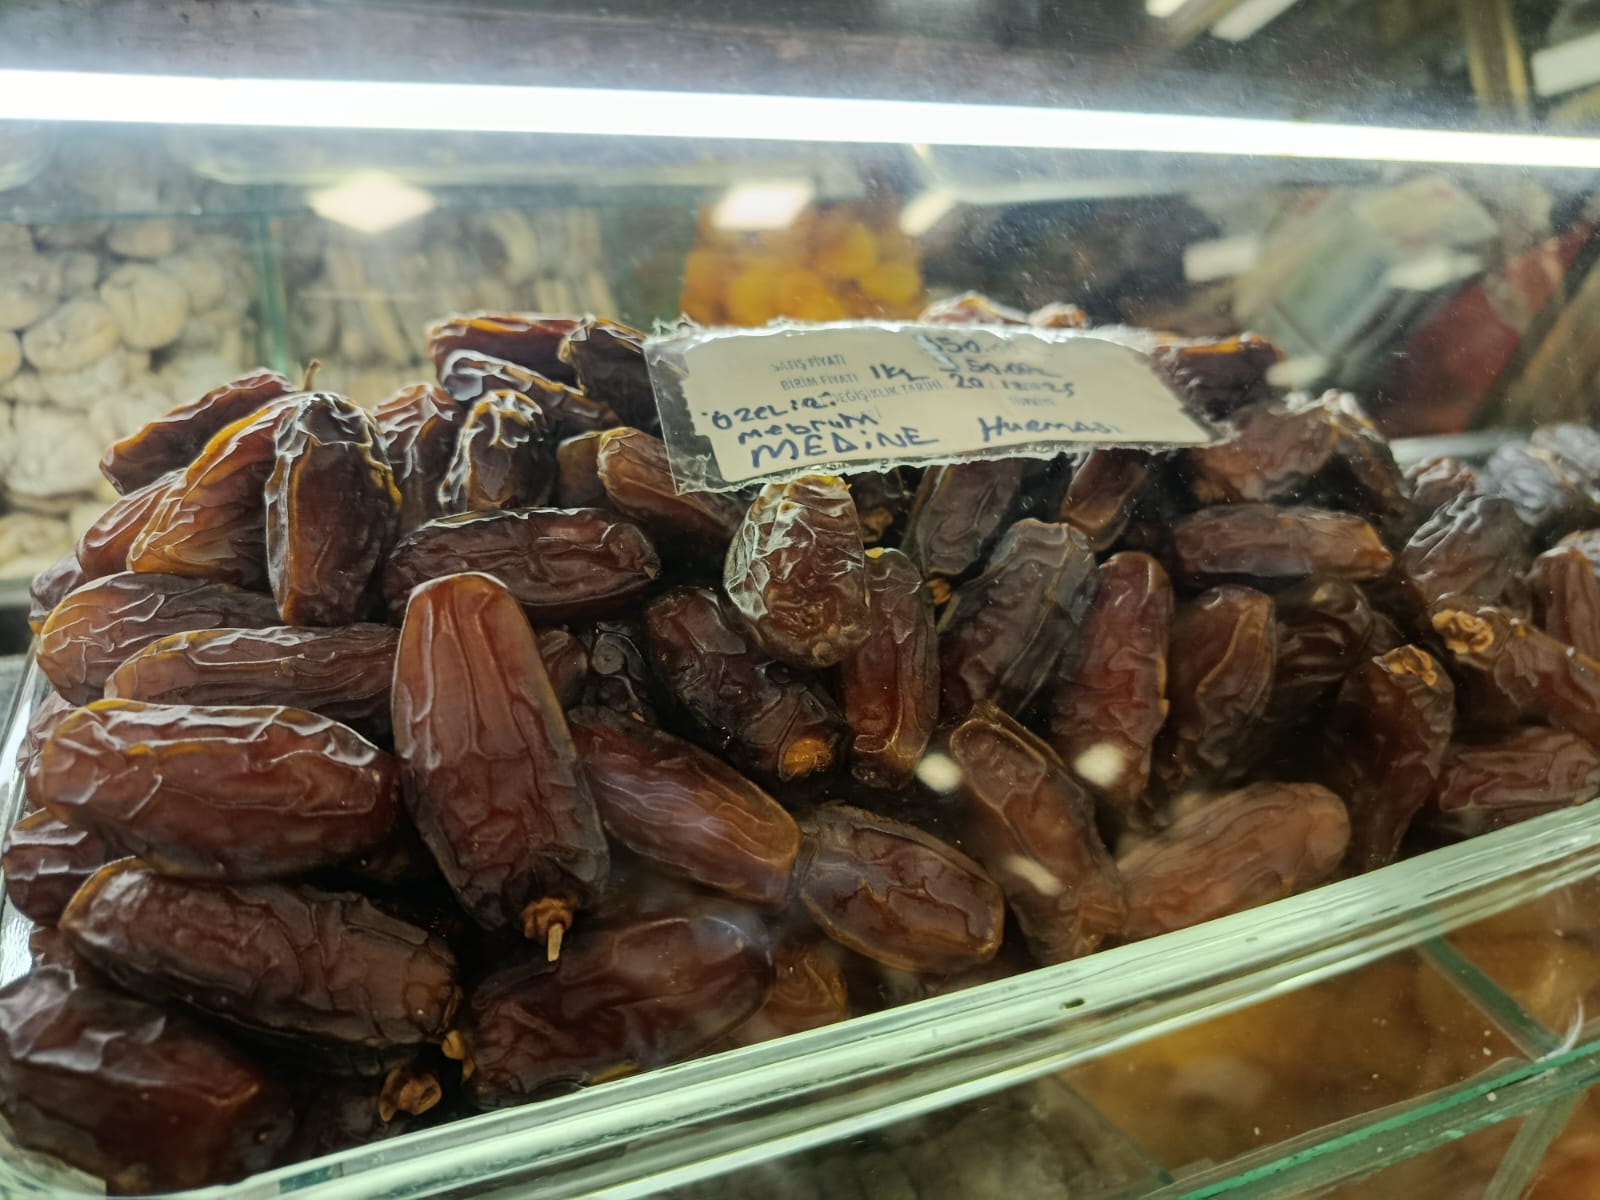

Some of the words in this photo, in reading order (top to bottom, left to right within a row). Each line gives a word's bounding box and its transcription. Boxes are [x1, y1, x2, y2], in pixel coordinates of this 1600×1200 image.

[808, 353, 847, 368] FİYATI
[780, 374, 818, 391] BİRİM
[820, 372, 860, 387] FİYATI
[900, 379, 944, 395] TARİHİ
